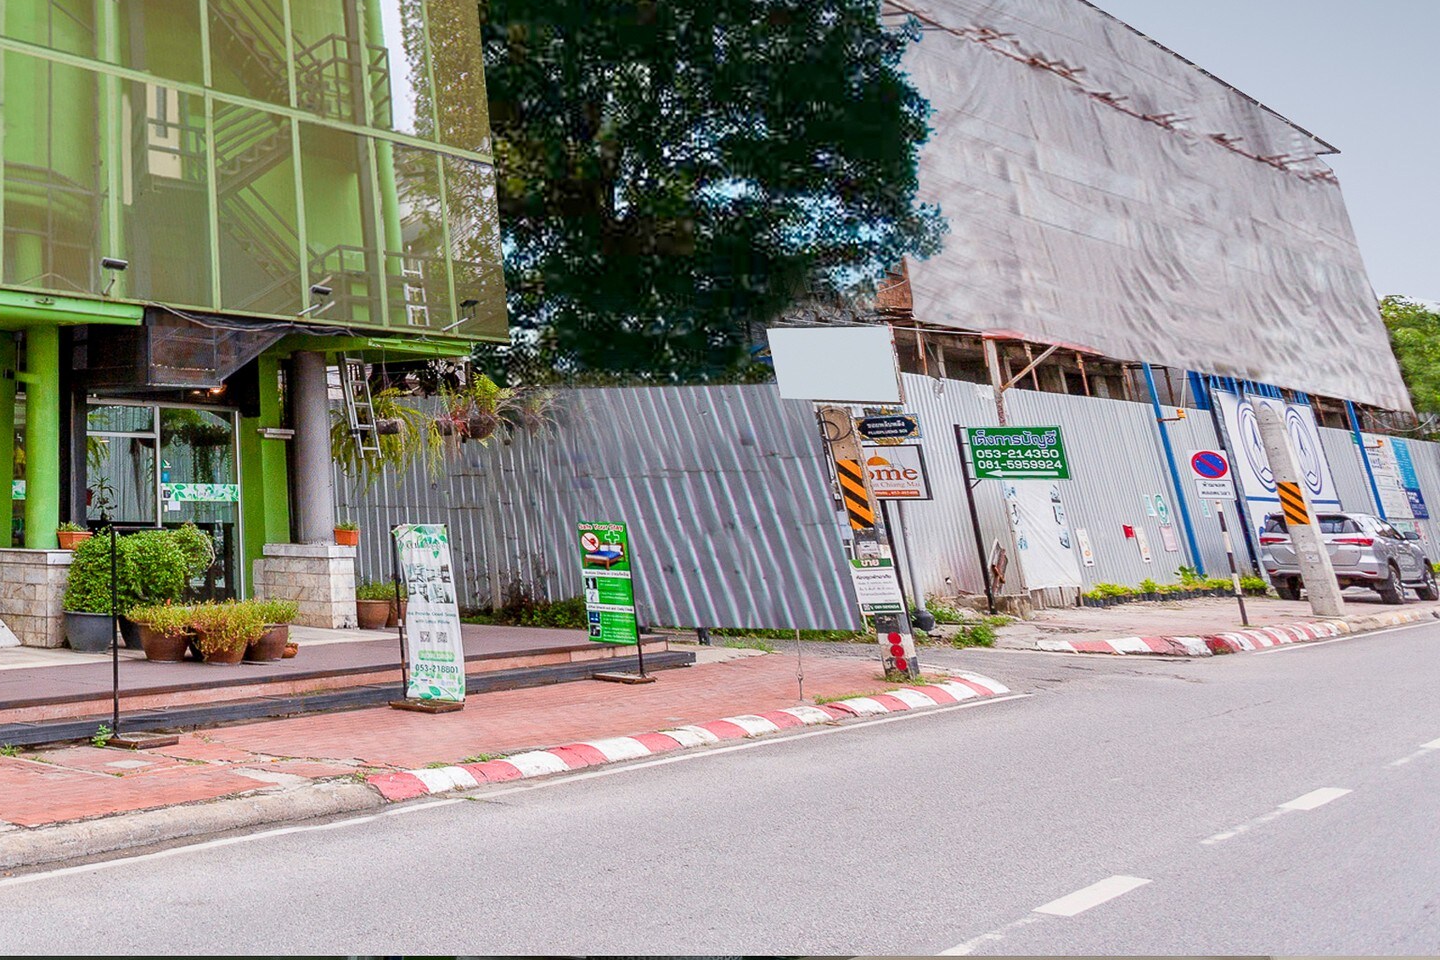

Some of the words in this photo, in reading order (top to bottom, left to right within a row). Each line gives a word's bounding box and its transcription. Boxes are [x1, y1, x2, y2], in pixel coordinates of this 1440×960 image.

[975, 449, 1060, 459] 053-214350
[978, 460, 1063, 469] 081-5959924
[415, 663, 459, 674] 053-218801
